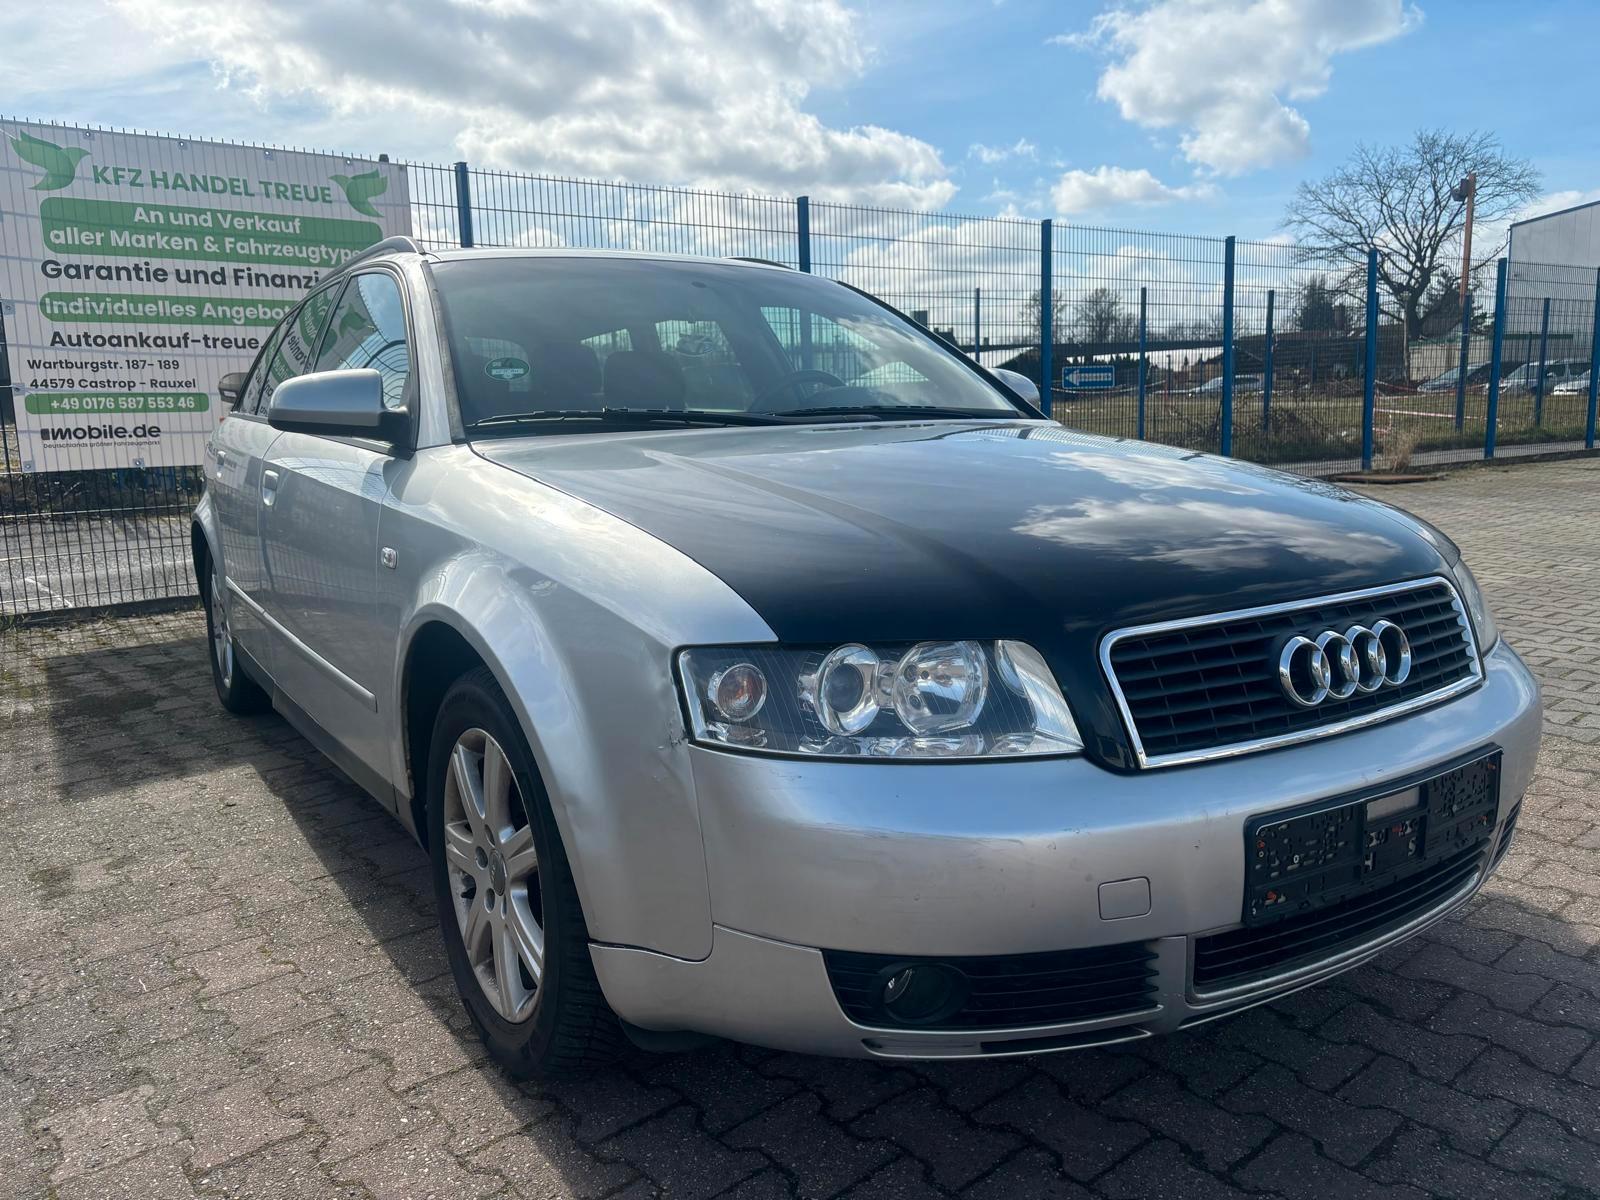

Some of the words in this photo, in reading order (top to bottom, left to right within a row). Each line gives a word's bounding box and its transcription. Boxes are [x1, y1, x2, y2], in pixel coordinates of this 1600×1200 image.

[92, 165, 145, 188] KFZ
[150, 170, 256, 197] HANDEL
[258, 181, 333, 204] TREUE
[133, 206, 165, 225] An
[169, 211, 213, 228] und
[216, 212, 301, 234] Verkauf
[50, 226, 105, 246] aller
[110, 230, 198, 251] Marken
[203, 235, 220, 253] &
[41, 259, 169, 283] Garantie
[175, 266, 227, 286] und
[45, 296, 197, 318] Individuelles
[27, 359, 123, 373] Wartburgstr.
[158, 359, 180, 370] 189
[30, 378, 75, 390] 44579
[78, 378, 136, 391] Castrop
[150, 378, 196, 389] Rauxel
[51, 397, 79, 411] +49
[82, 397, 115, 410] 0176
[118, 397, 144, 410] 587
[148, 397, 174, 409] 553
[177, 396, 195, 409] 46
[51, 424, 161, 440] mobile.de
